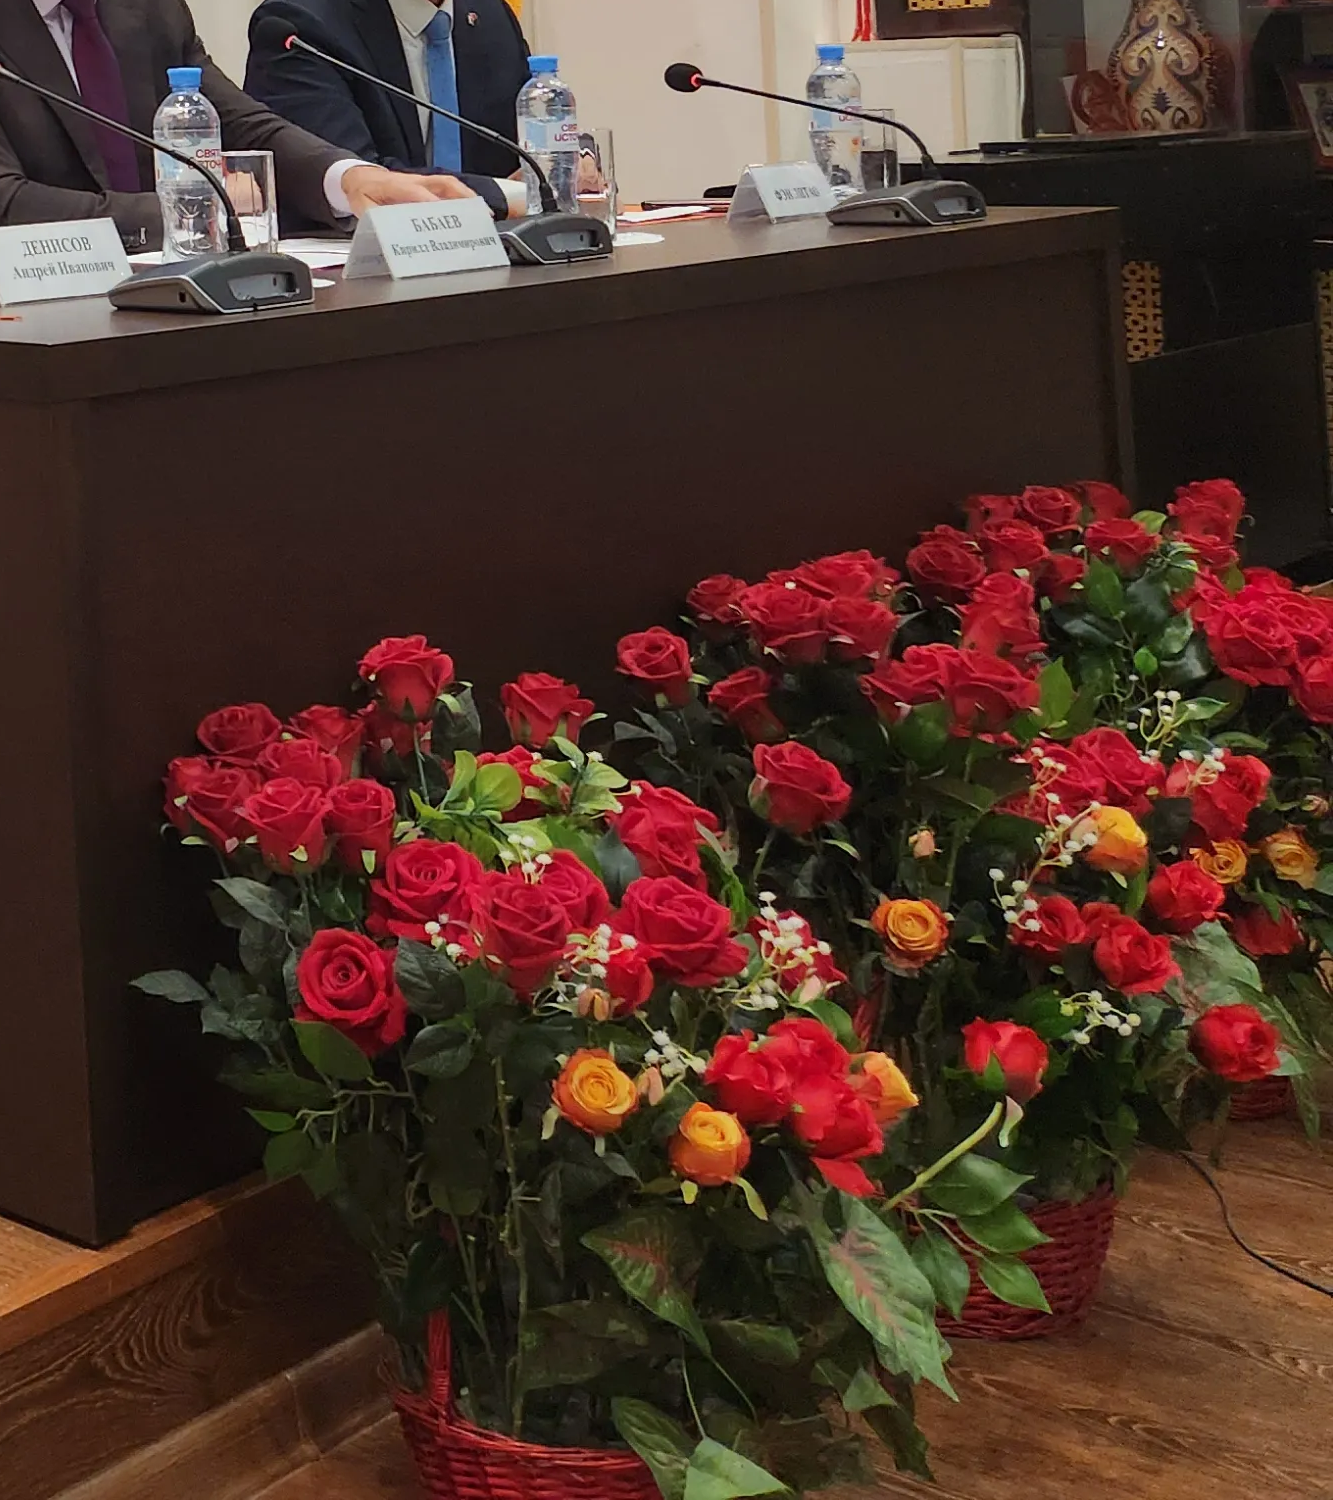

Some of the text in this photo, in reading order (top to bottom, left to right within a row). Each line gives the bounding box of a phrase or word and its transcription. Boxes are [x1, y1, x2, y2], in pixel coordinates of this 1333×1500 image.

[411, 214, 463, 233] БАБАЕВ
[21, 236, 92, 258] ДЕНИСОВ
[391, 242, 429, 259] Кирилл
[429, 236, 498, 254] Владимирович
[13, 260, 116, 281] Андрей Иванович
